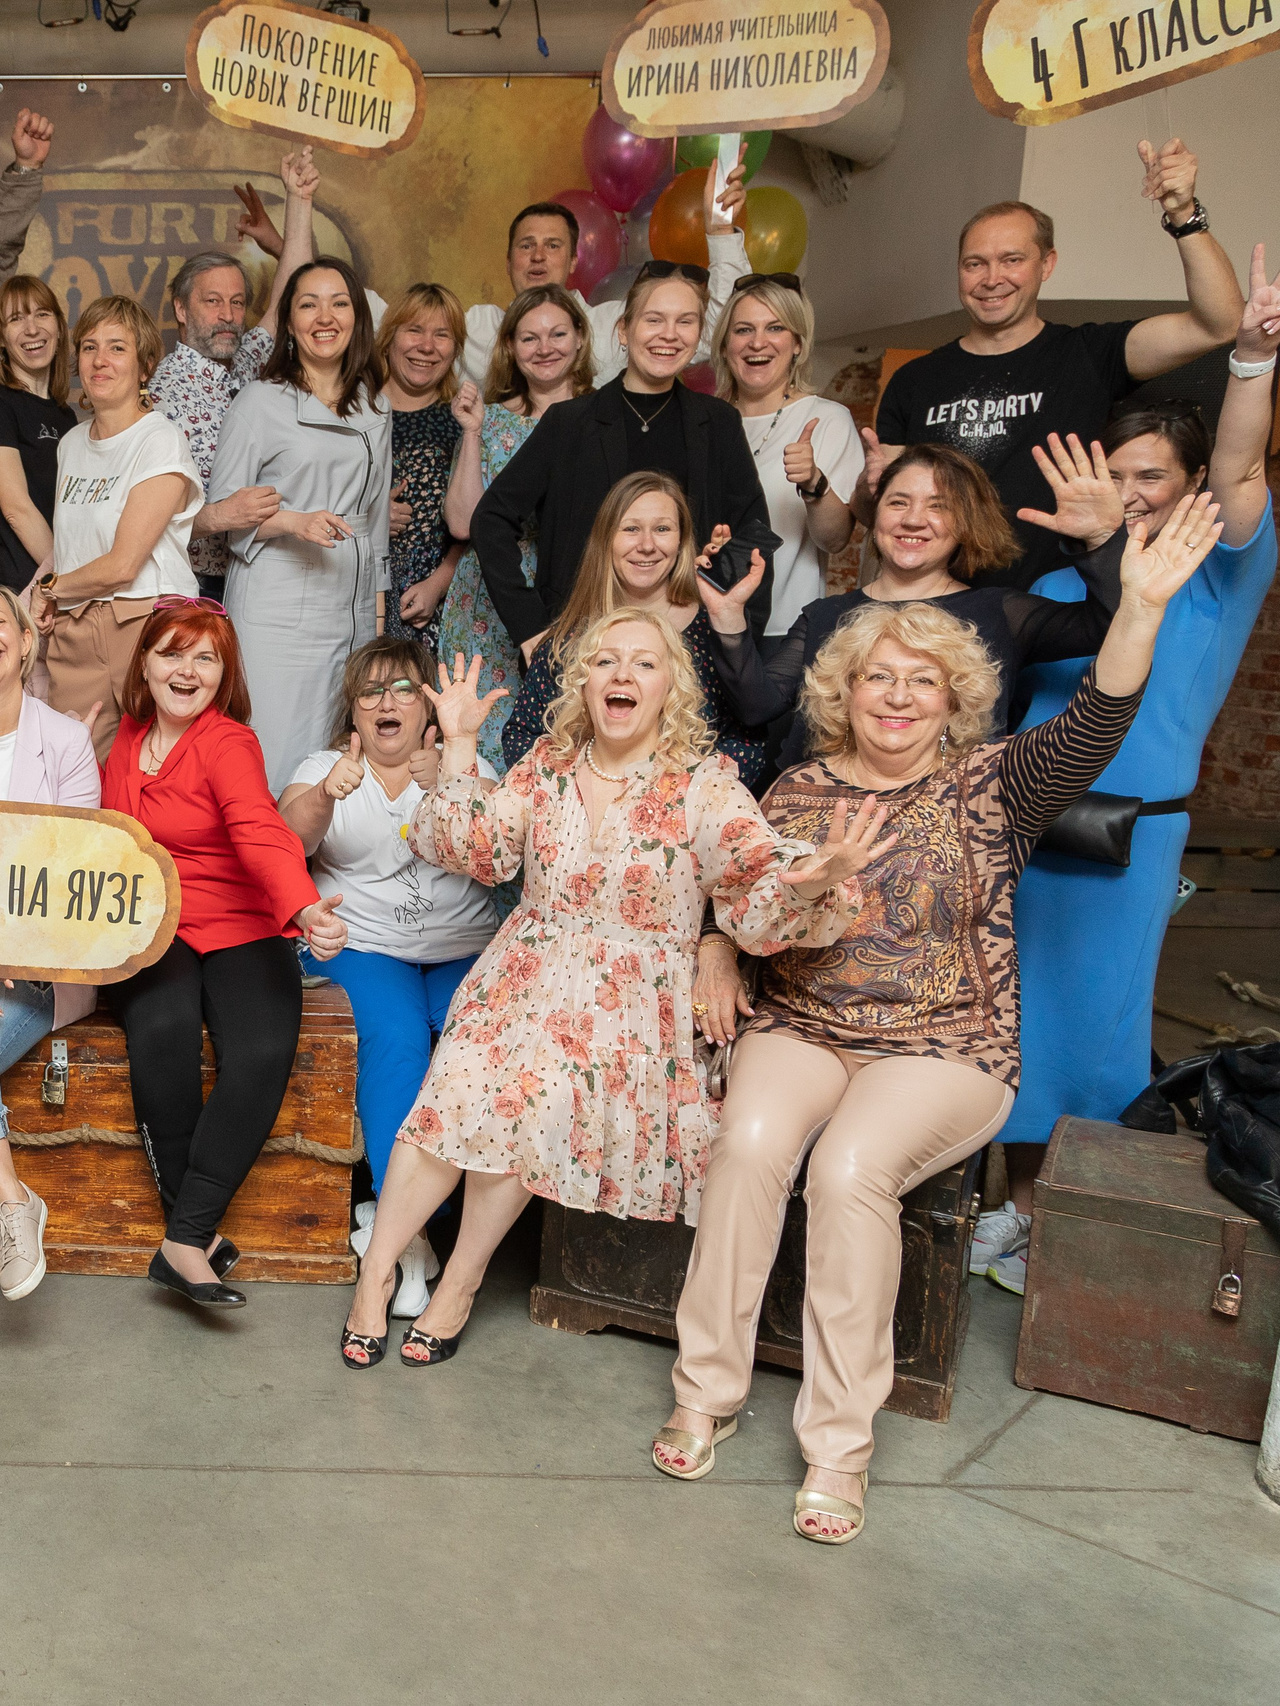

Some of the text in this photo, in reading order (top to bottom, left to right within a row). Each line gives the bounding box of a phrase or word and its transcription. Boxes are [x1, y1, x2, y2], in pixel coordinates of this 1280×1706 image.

[240, 14, 380, 87] ПОКОРЕНИЕ
[646, 20, 724, 51] ЛЮБИМАЯ
[729, 9, 838, 42] УЧИТЕЛЬНИЦА
[1030, 36, 1054, 102] 4
[1072, 17, 1089, 89] Г
[211, 56, 392, 134] НОВЫХ ВЕРШИН
[627, 46, 859, 99] ИРИНА НИКОЛАЕВНА
[925, 391, 1044, 426] LET'S PARTY
[8, 864, 49, 918] НА
[63, 869, 145, 926] ЯУЗЕ
